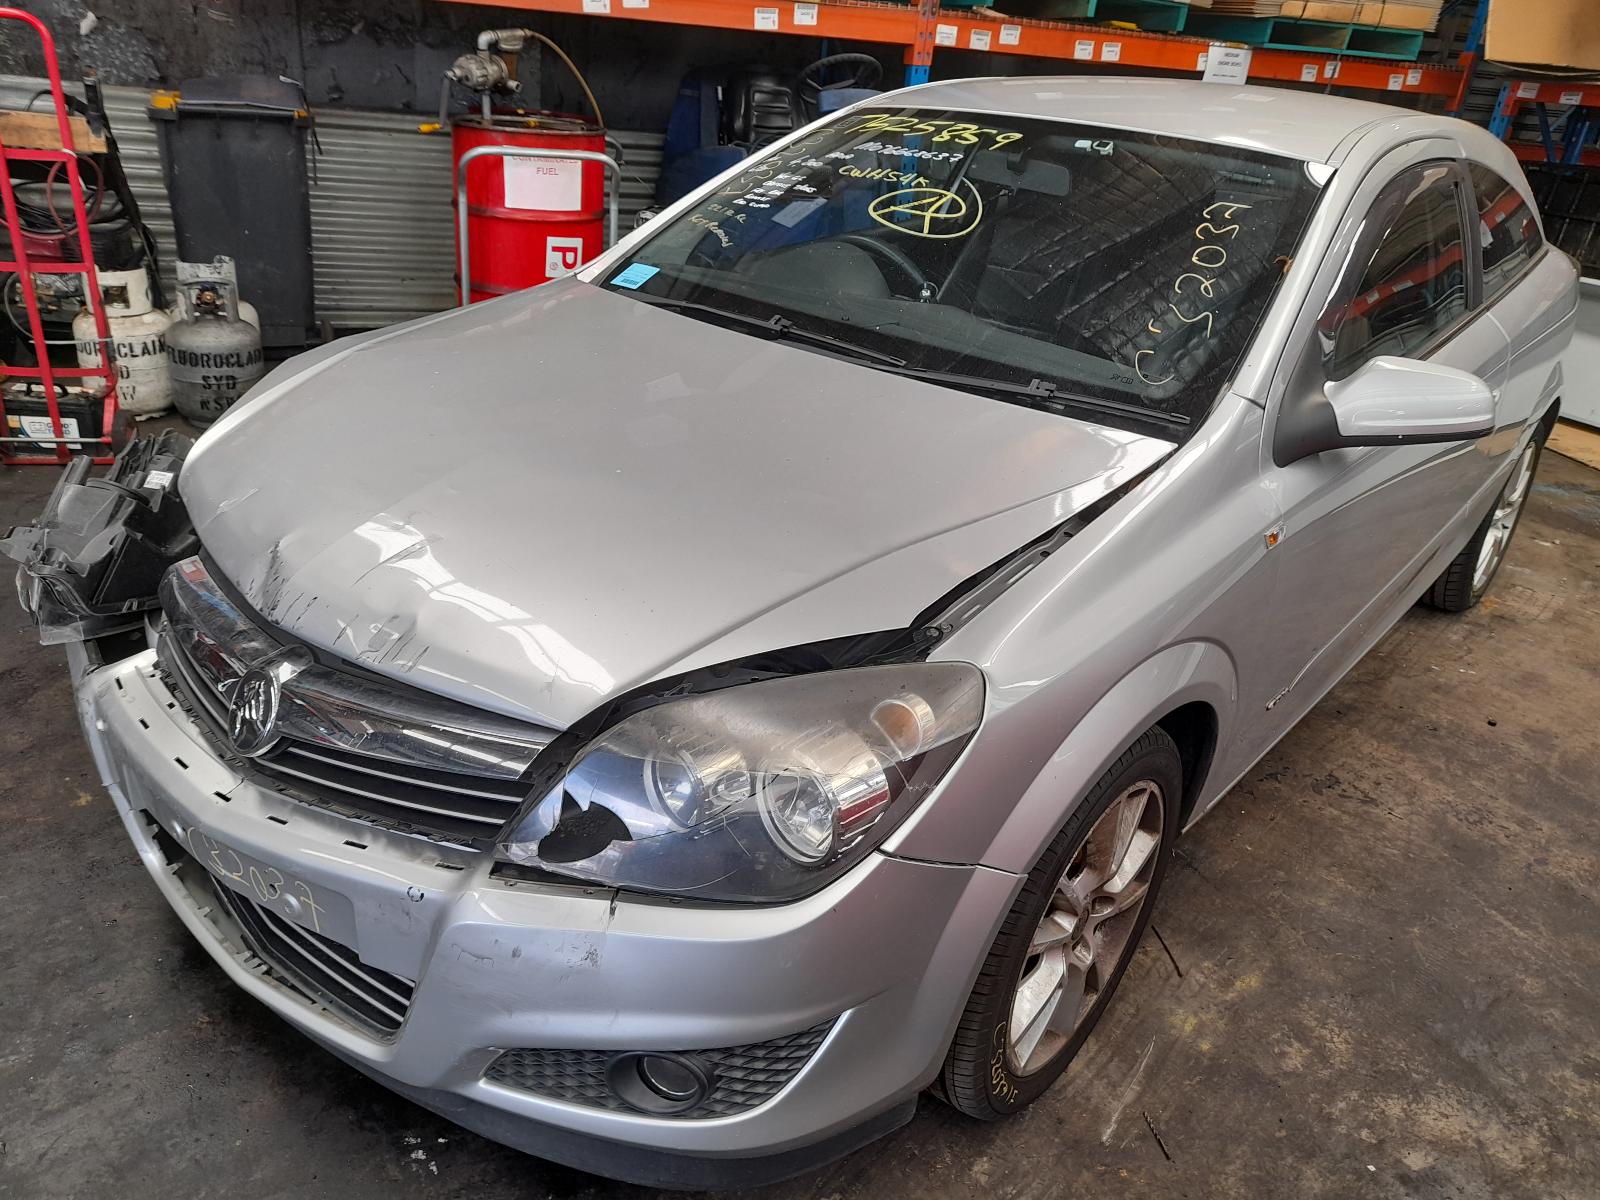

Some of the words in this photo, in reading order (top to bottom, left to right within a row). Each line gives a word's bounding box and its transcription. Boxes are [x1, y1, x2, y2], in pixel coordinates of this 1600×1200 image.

[536, 167, 559, 176] FUEL
[551, 246, 578, 270] P
[201, 375, 236, 390] SYD
